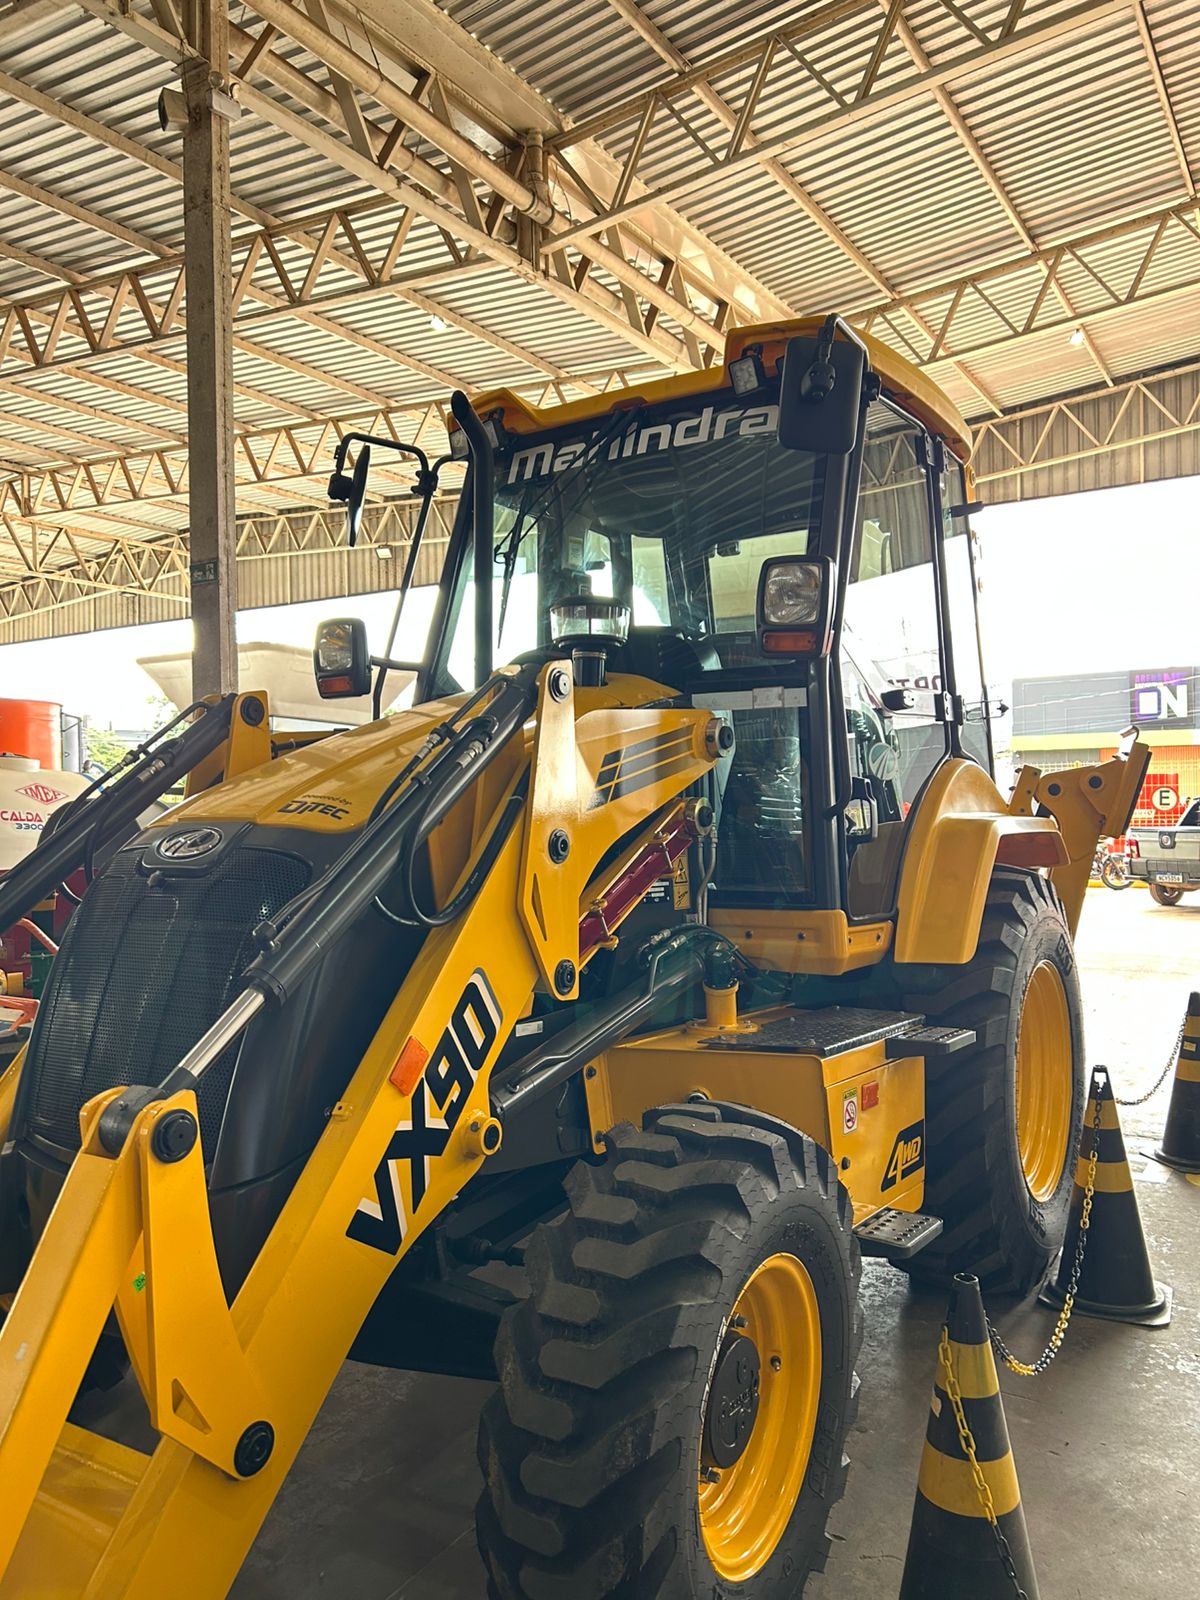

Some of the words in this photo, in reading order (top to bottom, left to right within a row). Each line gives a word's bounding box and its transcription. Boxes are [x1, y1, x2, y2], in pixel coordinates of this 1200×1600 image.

[1135, 684, 1188, 719] ON
[1159, 790, 1170, 806] E
[0, 811, 43, 822] CALDA
[345, 976, 500, 1256] VX90
[887, 1136, 922, 1184] 4WD
